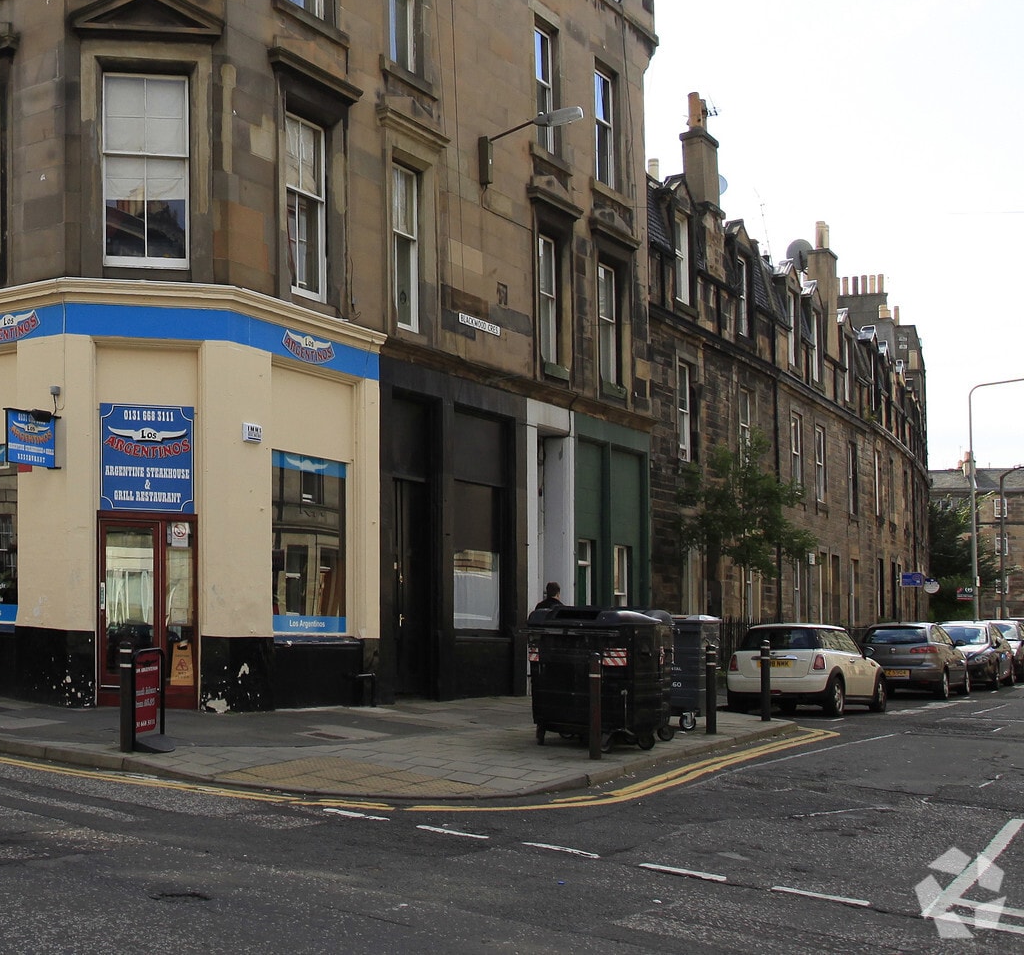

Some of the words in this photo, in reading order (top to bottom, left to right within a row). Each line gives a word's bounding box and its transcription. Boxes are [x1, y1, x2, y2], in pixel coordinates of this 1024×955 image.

[461, 315, 487, 330] BLACKWOOD
[305, 338, 314, 347] Los
[284, 337, 333, 362] ARGENTINOS
[123, 410, 140, 420] 0131
[143, 410, 156, 421] 668
[158, 411, 174, 422] 3111
[141, 430, 157, 440] Los
[104, 435, 191, 459] ARGENTINOS
[105, 465, 145, 478] ARGENTINE
[146, 467, 190, 480] STEAKHOUSE
[144, 479, 151, 490] &
[114, 490, 134, 501] GRILL
[135, 491, 182, 503] RESTAURANT
[299, 620, 326, 629] Argentinos
